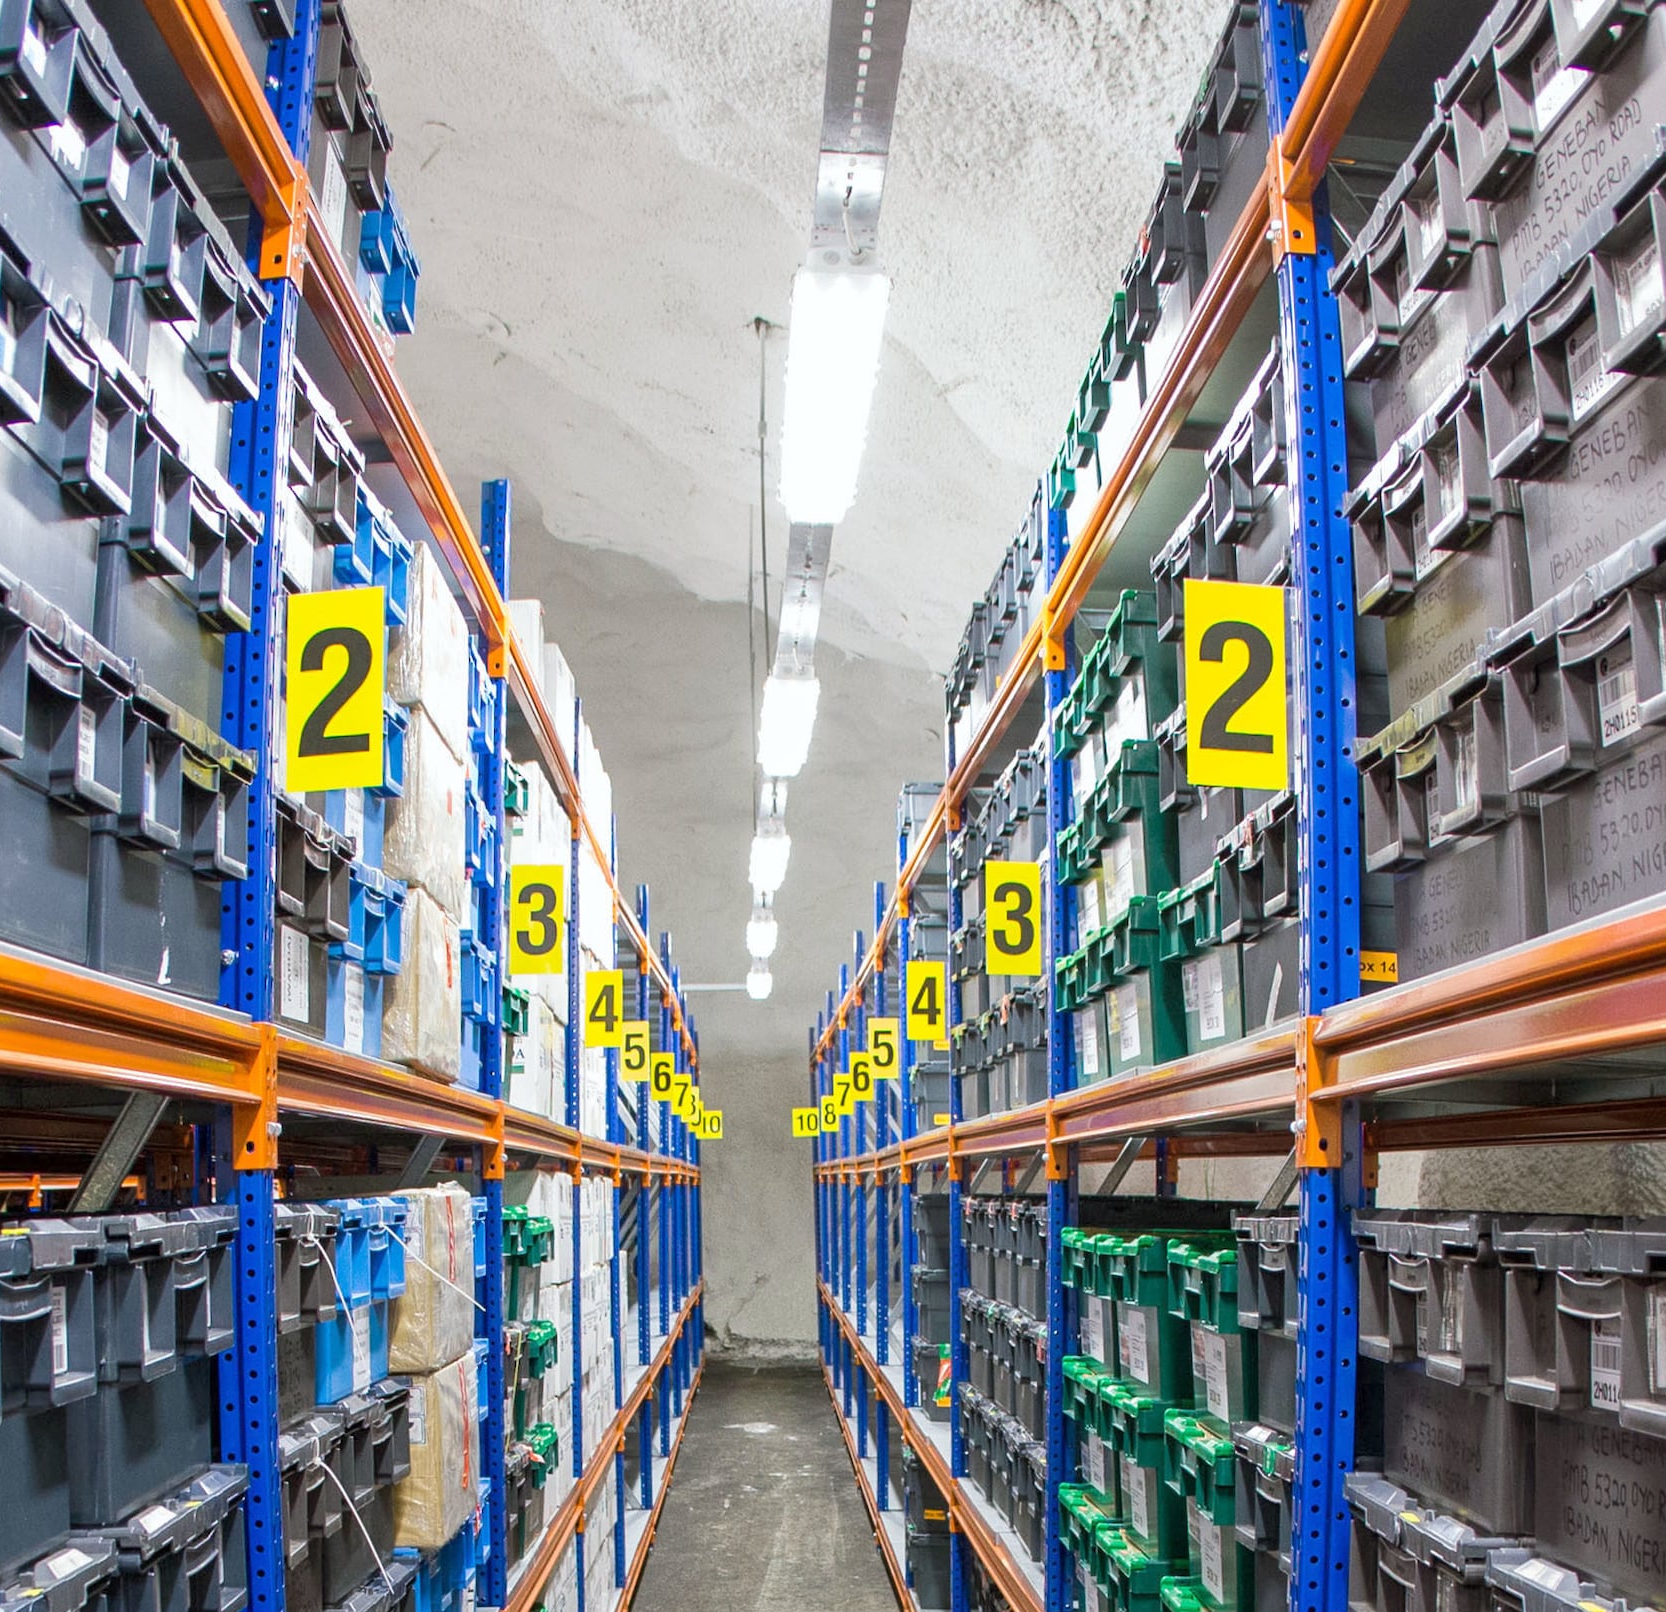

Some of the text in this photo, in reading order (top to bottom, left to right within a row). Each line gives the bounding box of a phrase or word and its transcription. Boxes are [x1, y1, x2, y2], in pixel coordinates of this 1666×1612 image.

[298, 626, 373, 758] 2
[1198, 621, 1274, 754] 2
[516, 882, 558, 956] 3
[993, 882, 1034, 955] 3
[1381, 961, 1396, 974] 14
[589, 984, 618, 1032] 4
[911, 976, 941, 1026] 4
[624, 1033, 645, 1070] 5
[872, 1030, 894, 1066] 5
[654, 1061, 671, 1092] 6
[853, 1061, 870, 1091] 6
[674, 1082, 689, 1107] 7
[837, 1082, 851, 1106] 7
[703, 1116, 720, 1133] 10
[797, 1114, 818, 1132] 10
[824, 1104, 836, 1125] 8
